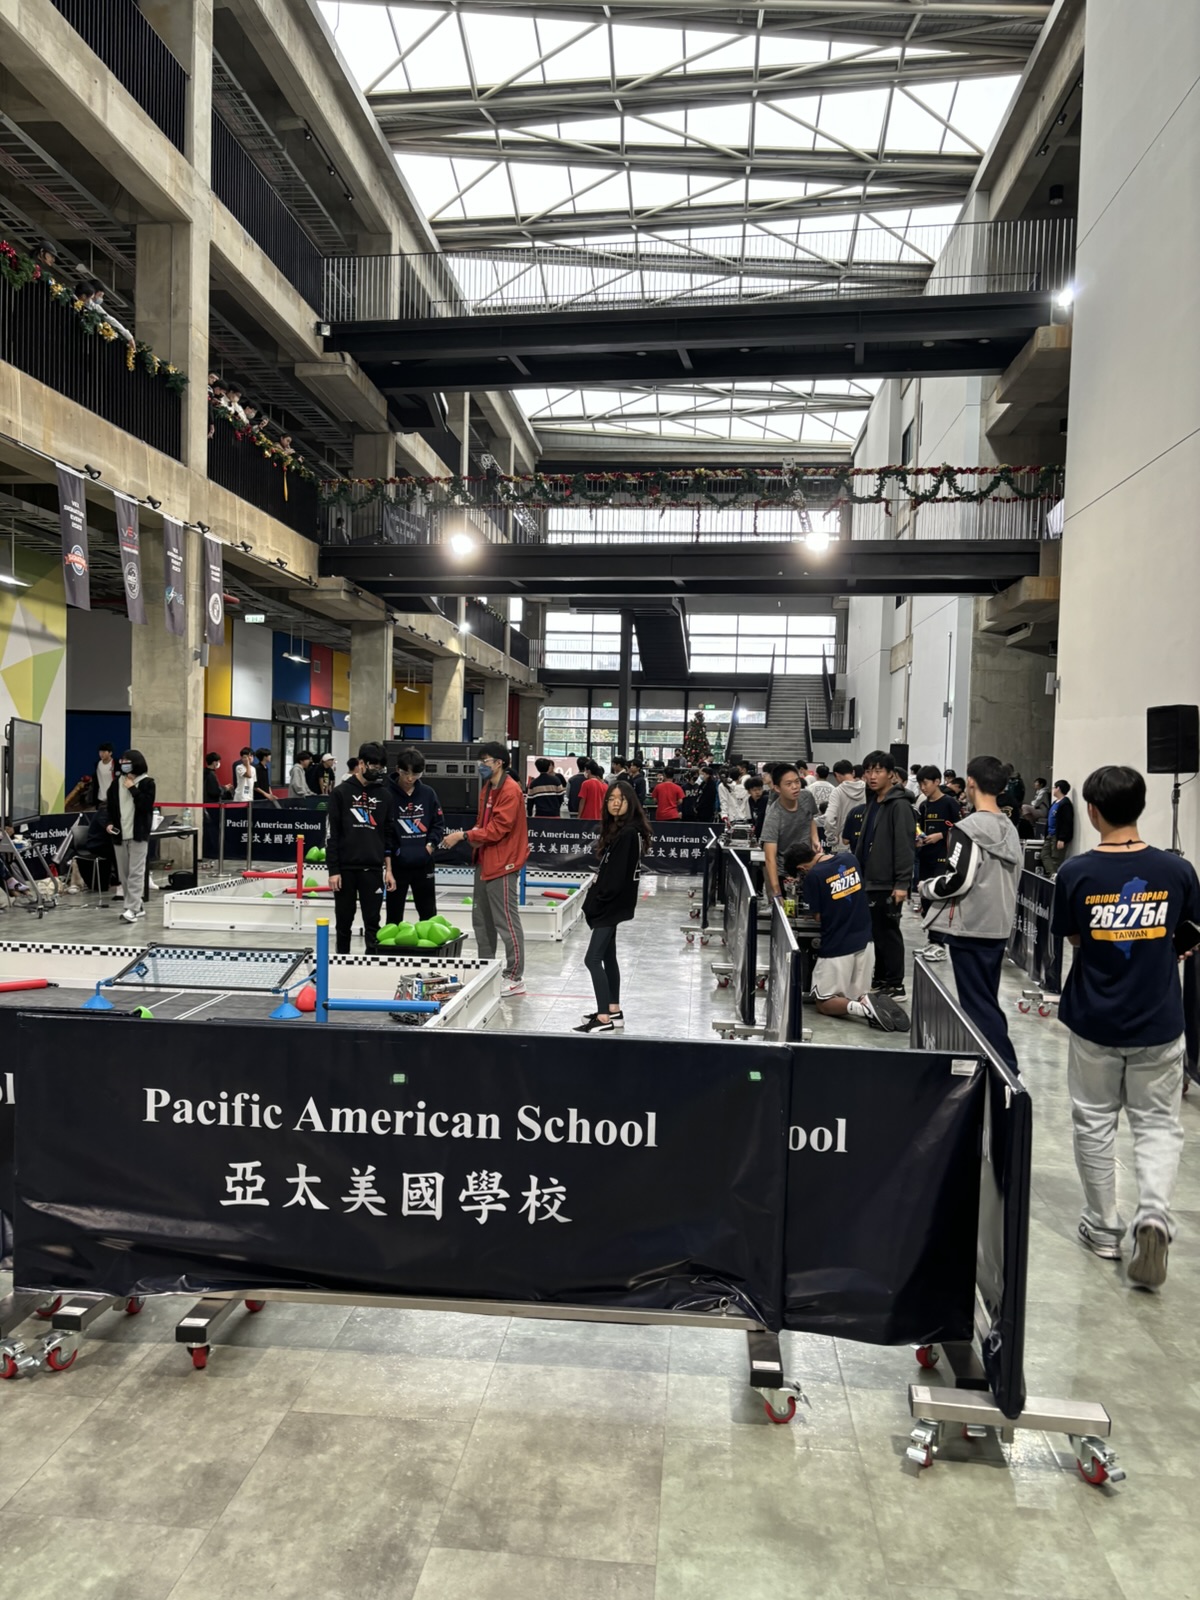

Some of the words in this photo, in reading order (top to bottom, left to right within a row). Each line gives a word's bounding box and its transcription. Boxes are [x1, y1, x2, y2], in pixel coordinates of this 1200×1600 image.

[226, 819, 249, 828] Pacifi
[254, 820, 293, 829] American
[294, 821, 321, 830] School
[539, 830, 580, 839] American
[659, 834, 700, 844] American
[830, 871, 861, 895] 26275A
[1085, 893, 1121, 905] CURIOUS
[1131, 890, 1169, 902] LEOPARD
[1089, 902, 1169, 929] 26275A
[1113, 930, 1148, 940] TAIWAN
[142, 1087, 283, 1130] Pacific
[292, 1096, 501, 1140] American
[516, 1105, 658, 1148] School
[788, 1117, 848, 1153] ool
[219, 1160, 573, 1225] 亞太美國學校
